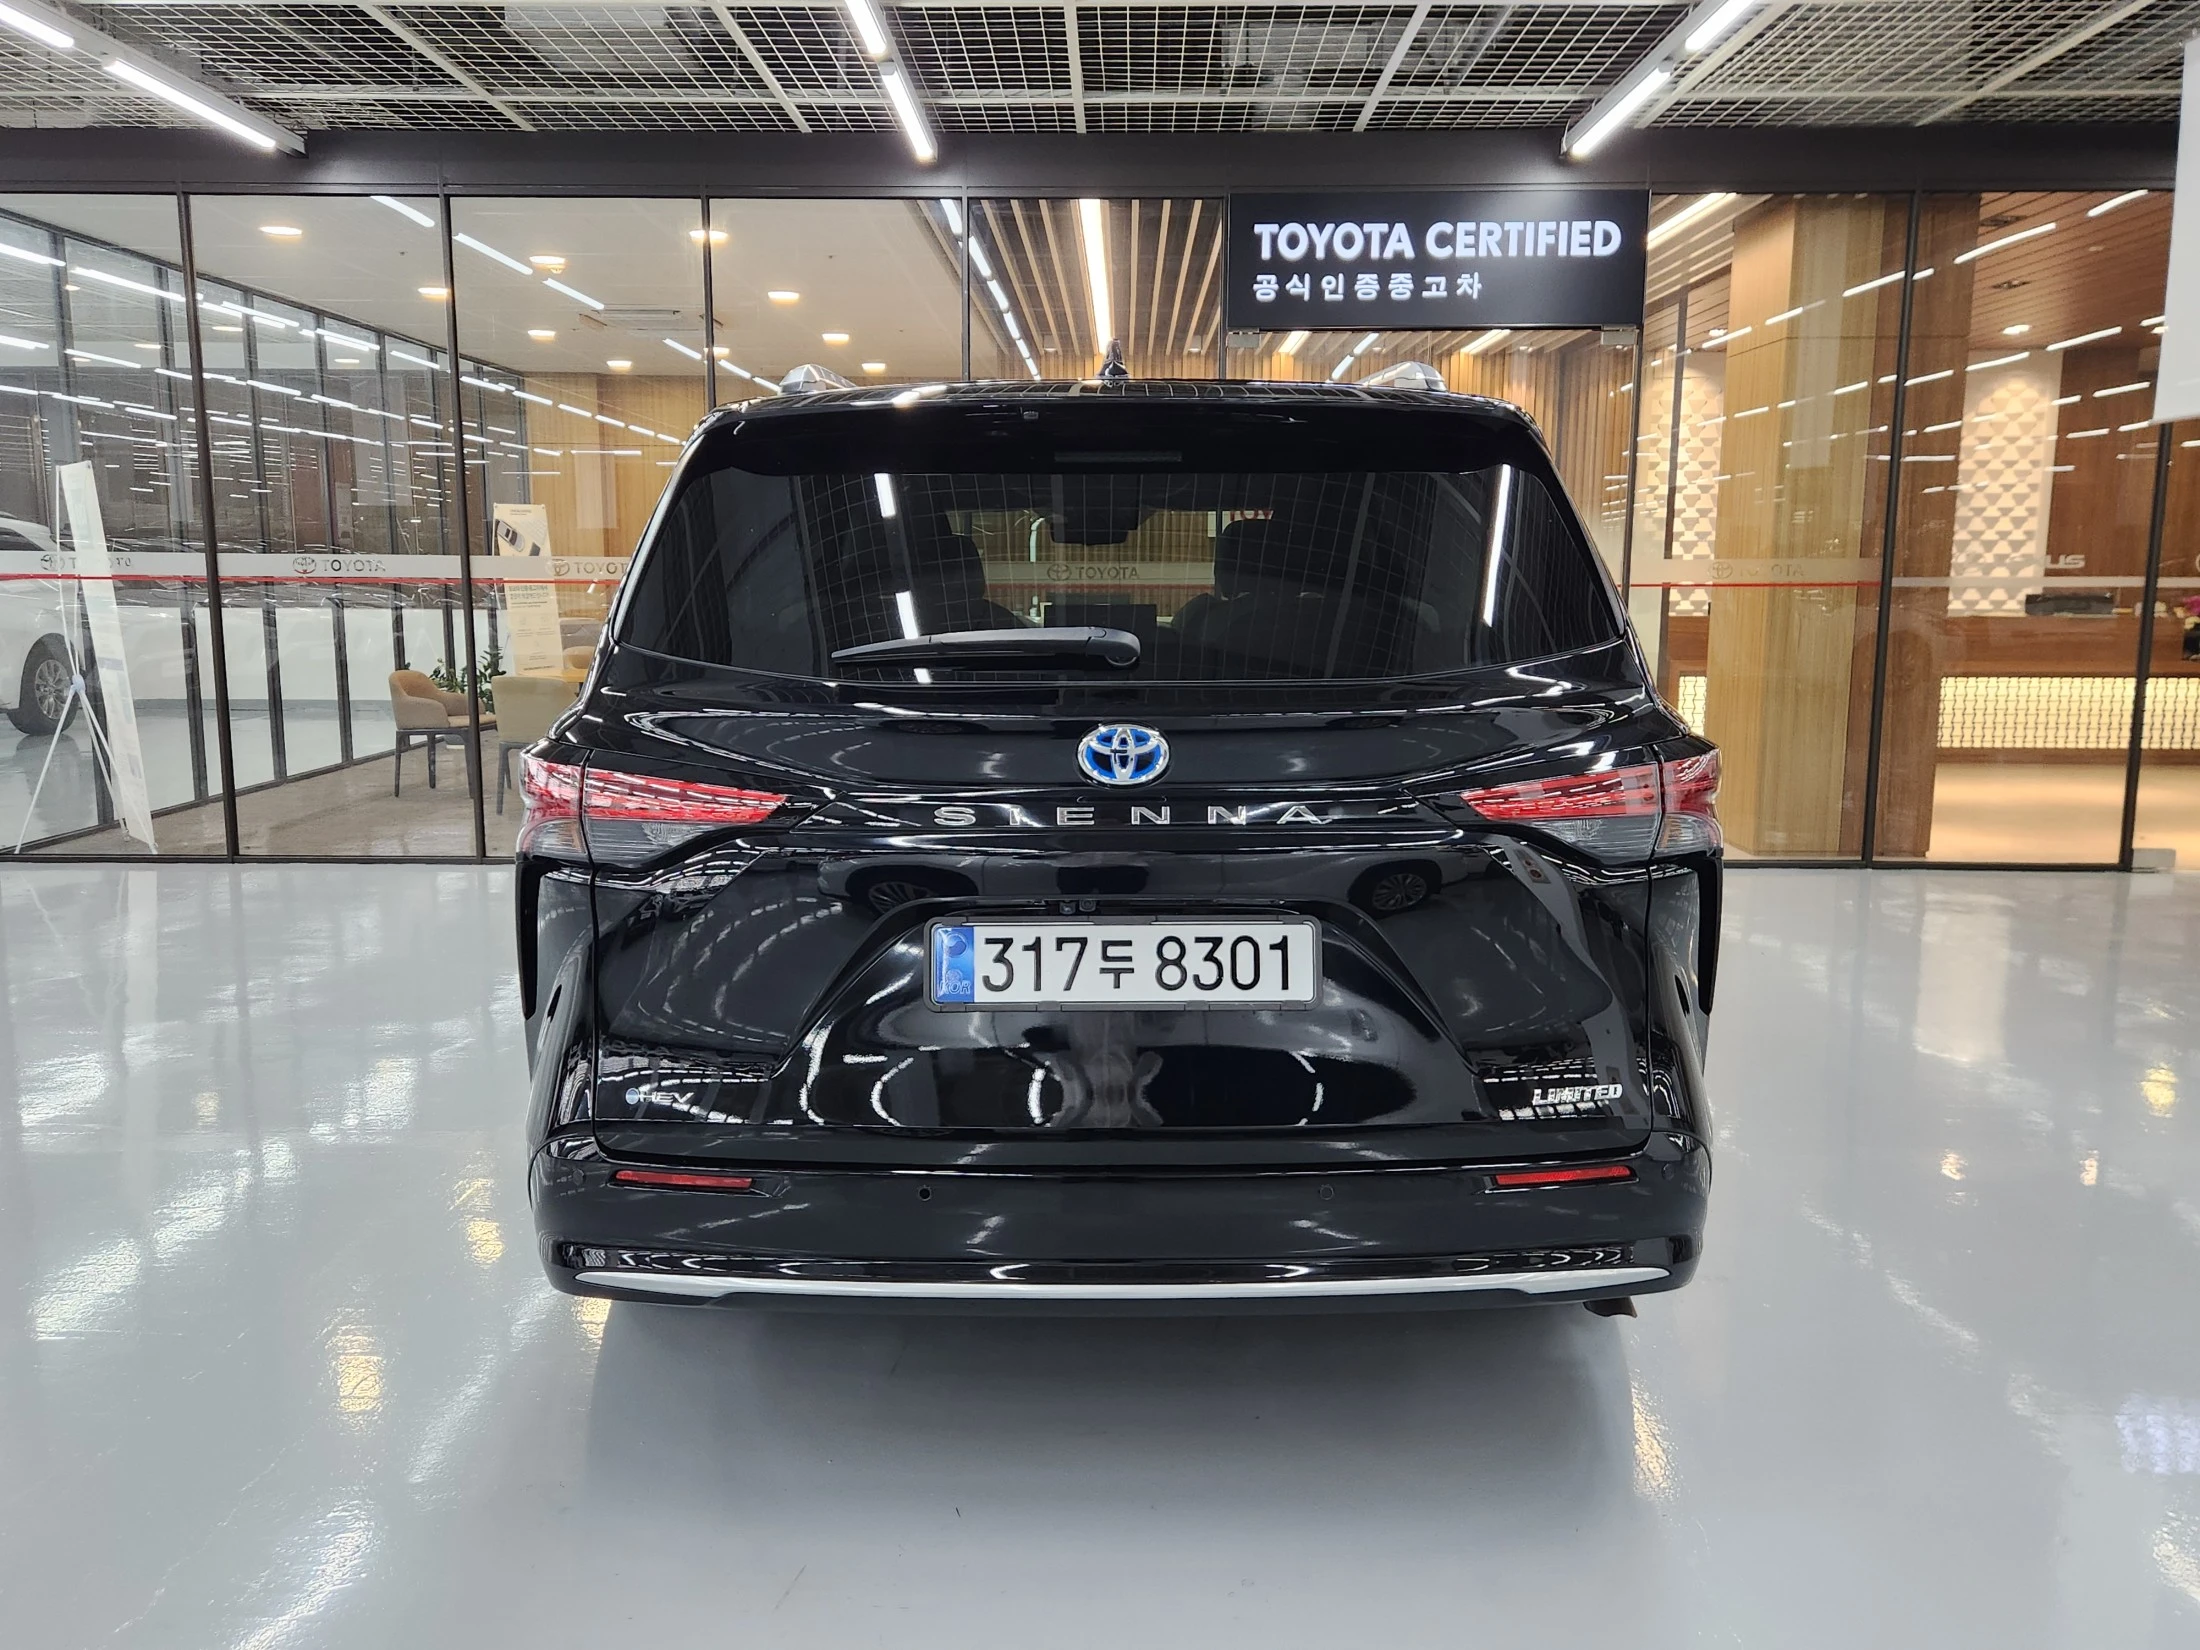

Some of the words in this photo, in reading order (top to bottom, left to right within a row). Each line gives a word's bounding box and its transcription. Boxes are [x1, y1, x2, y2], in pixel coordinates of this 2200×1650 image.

[1253, 221, 1415, 261] TOYOTA
[1426, 219, 1622, 258] CERTIFIED
[1252, 271, 1483, 302] 공식인증중고차
[320, 559, 386, 572] TOYOTA
[574, 562, 629, 574] TOYOT
[1075, 566, 1140, 579] TOYOTA
[932, 805, 1331, 827] SIENNA
[982, 935, 1135, 992] 317두
[1155, 934, 1290, 992] 8301
[939, 980, 971, 994] KOR
[639, 1091, 695, 1104] HEV
[1532, 1083, 1623, 1106] LIMITED
